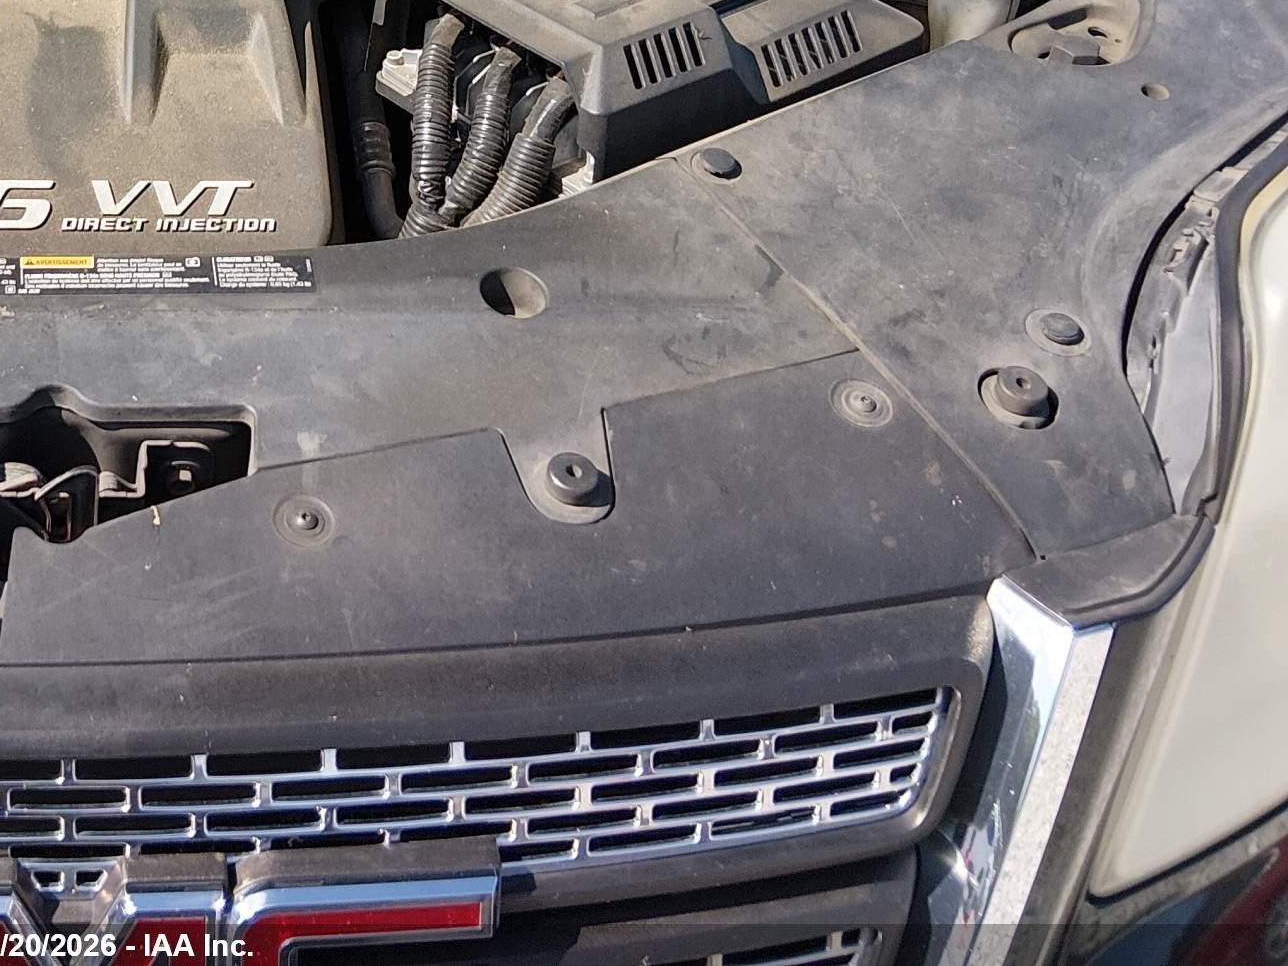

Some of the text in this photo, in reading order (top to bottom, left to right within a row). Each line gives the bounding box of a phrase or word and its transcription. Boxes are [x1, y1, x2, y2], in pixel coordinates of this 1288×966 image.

[91, 179, 254, 217] VVT
[62, 217, 277, 233] DIRECT INJECTION
